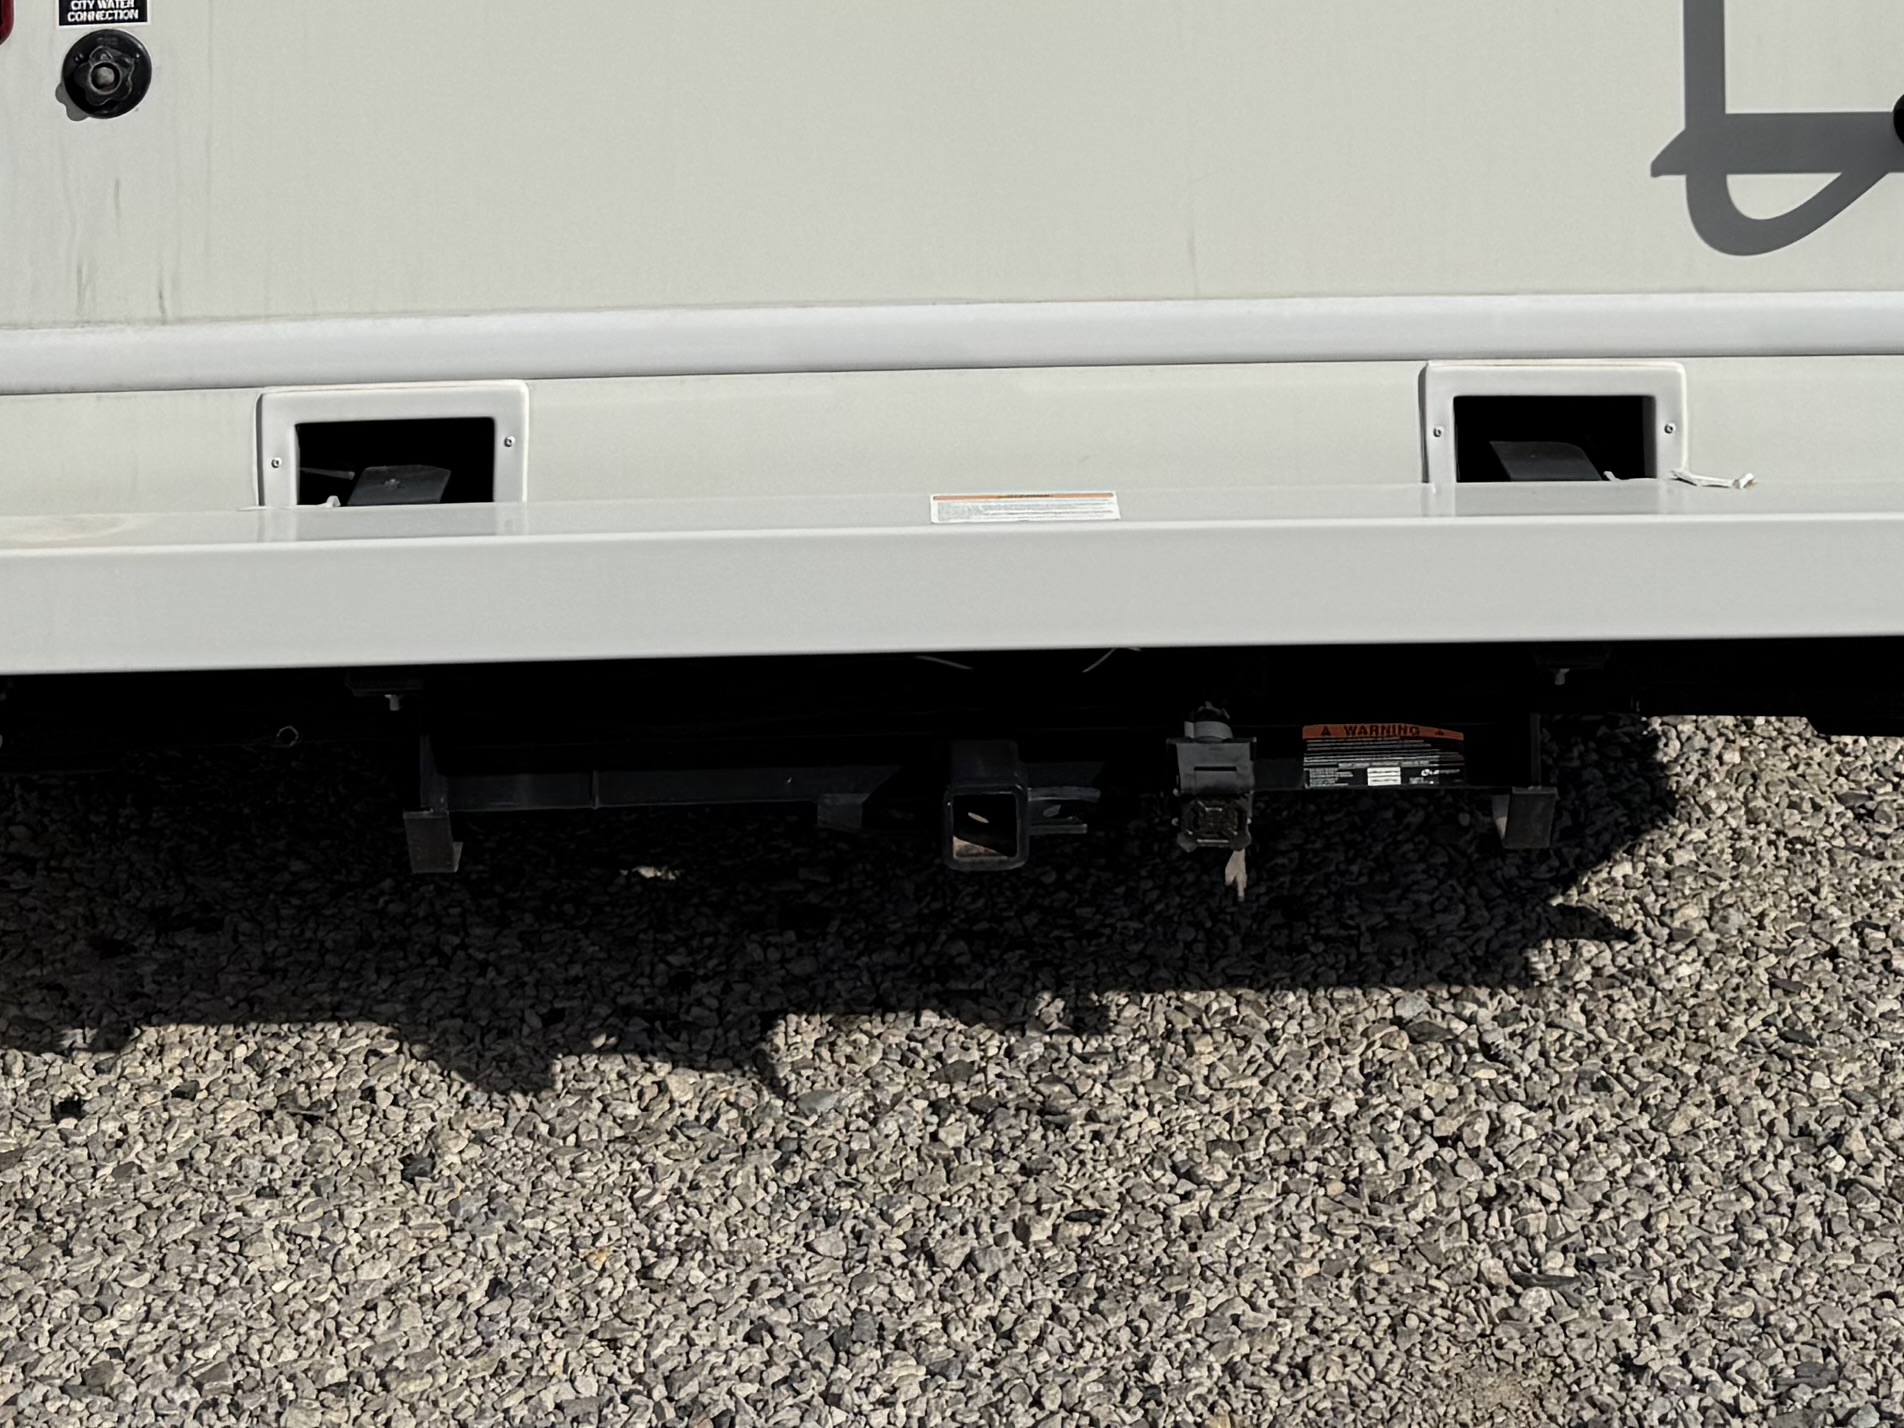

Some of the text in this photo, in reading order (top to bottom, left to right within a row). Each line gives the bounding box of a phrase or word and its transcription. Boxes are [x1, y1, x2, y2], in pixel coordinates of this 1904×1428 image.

[70, 0, 96, 11] CITY
[67, 8, 139, 23] CONNECTION
[1344, 724, 1421, 736] WARNING
